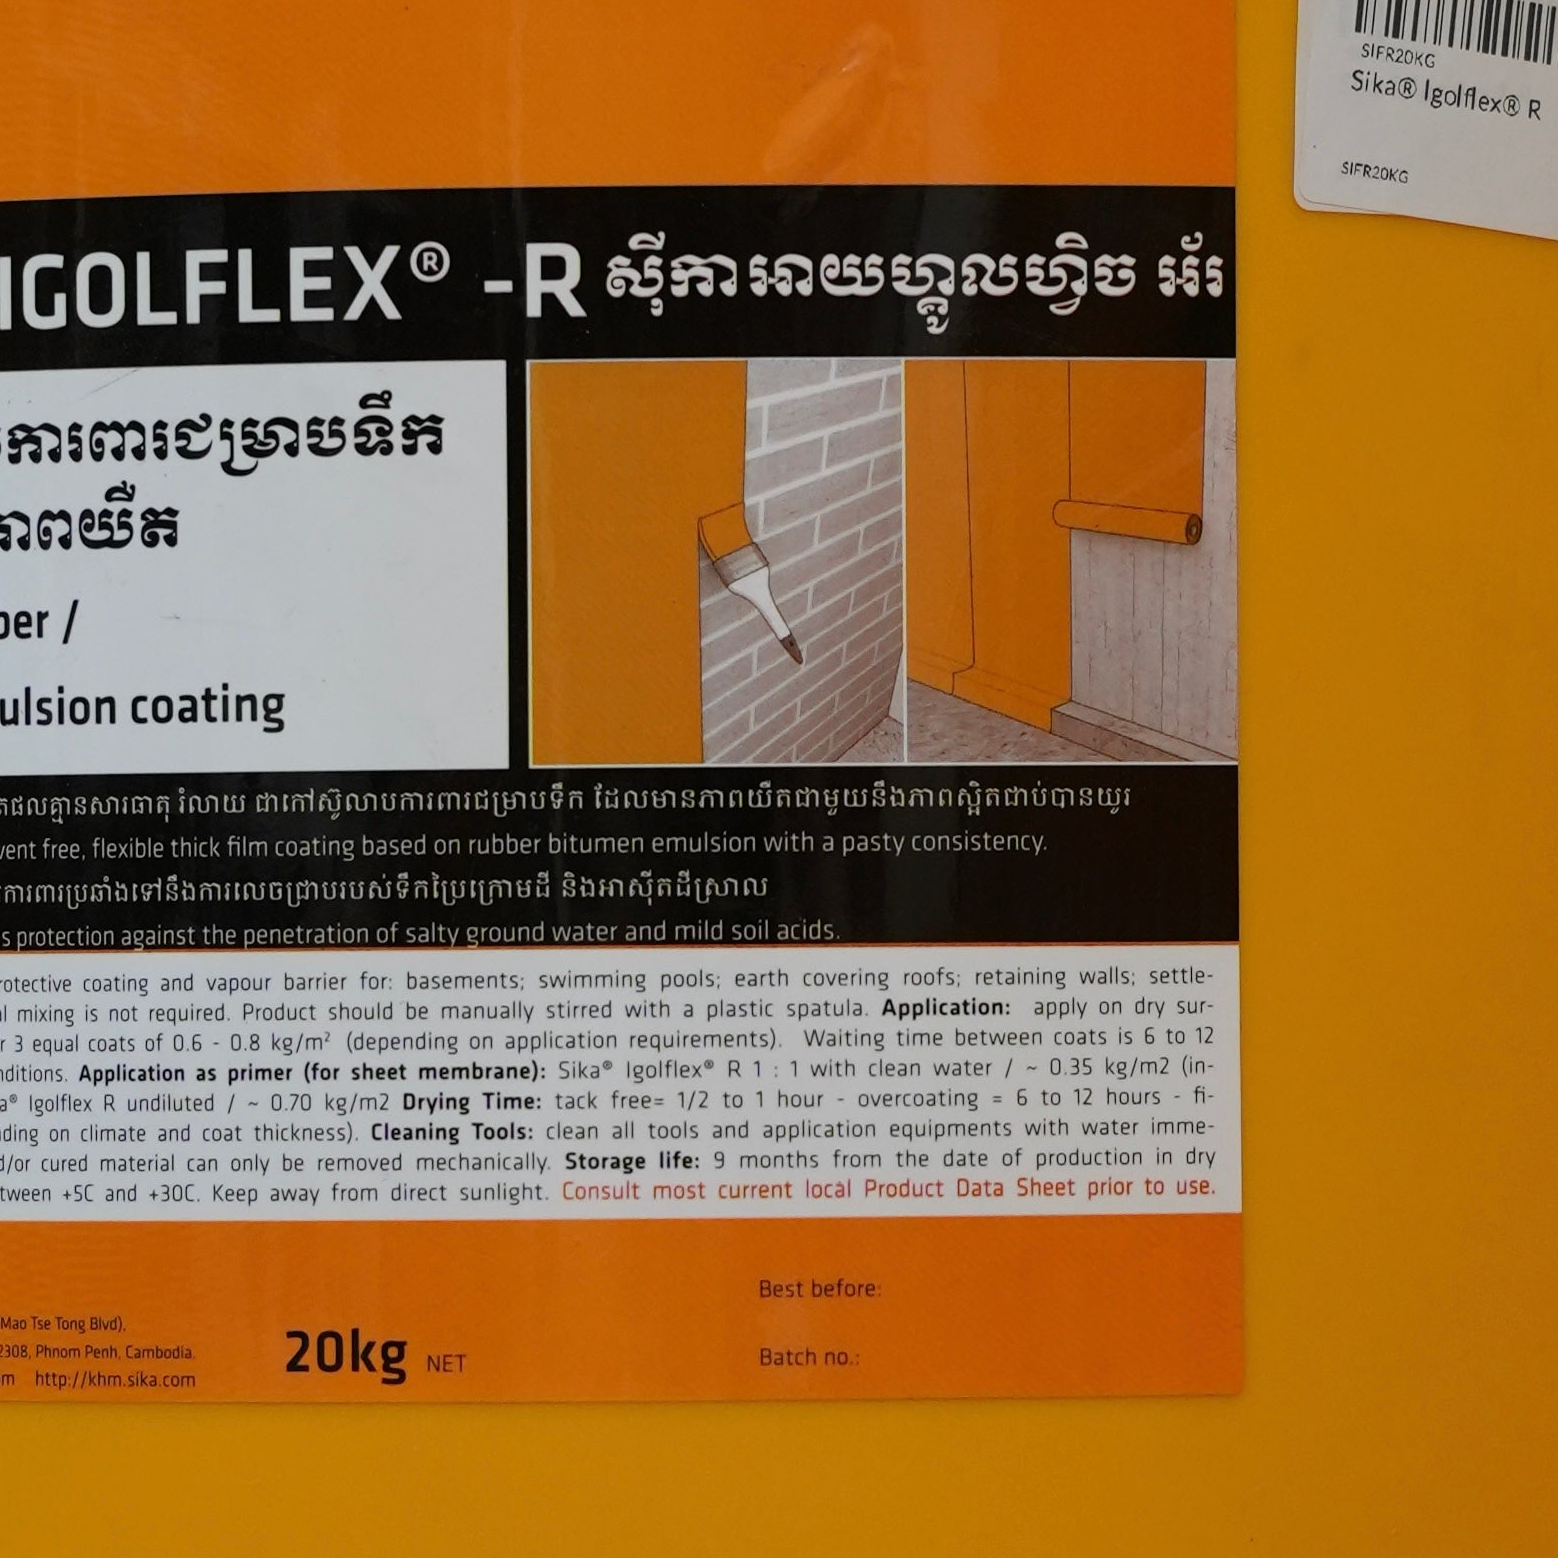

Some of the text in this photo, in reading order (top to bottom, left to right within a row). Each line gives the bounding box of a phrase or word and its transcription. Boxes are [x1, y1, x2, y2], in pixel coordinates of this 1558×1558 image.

[1360, 42, 1436, 70] SIFR20KG
[1350, 69, 1542, 121] Sika® Igolflex® R
[1340, 160, 1409, 185] SIFR20KG
[61, 598, 80, 645] /
[130, 682, 286, 734] coating
[42, 837, 86, 861] free,
[91, 836, 164, 859] flexible
[170, 835, 221, 858] thick
[226, 834, 268, 857] film
[274, 834, 355, 862] coating
[362, 833, 427, 857] based
[433, 838, 461, 856] on
[468, 832, 542, 855] rubber
[548, 832, 644, 855] bitumen
[651, 830, 756, 854] emulsion
[763, 830, 814, 853] with
[822, 835, 835, 852] a
[842, 832, 905, 857] pasty
[911, 829, 1047, 856] consistency.
[16, 924, 115, 951] protection
[121, 923, 196, 950] against
[201, 923, 237, 946] the
[243, 922, 369, 950] penetration
[376, 921, 399, 944] of
[405, 921, 460, 948] salty
[466, 920, 545, 948] ground
[551, 922, 619, 943] water
[625, 919, 666, 942] and
[674, 919, 723, 942] mild
[730, 918, 769, 941] soil
[776, 918, 840, 941] acids.
[82, 973, 149, 997] coating
[160, 972, 194, 992] and
[205, 976, 272, 996] vapour
[284, 971, 348, 992] barrier
[359, 970, 392, 991] for:
[406, 970, 524, 991] basements;
[538, 969, 647, 994] swimming
[660, 968, 721, 993] pools;
[734, 968, 789, 988] earth
[802, 967, 890, 992] covering
[903, 966, 961, 988] roofs;
[975, 966, 1067, 991] retaining
[1079, 965, 1135, 987] walls;
[1149, 965, 1214, 985] settle-
[62, 1183, 95, 1203] +5C
[104, 1183, 137, 1203] and
[148, 1183, 201, 1203] +30C.
[212, 1183, 258, 1208] Keep
[269, 1187, 321, 1207] away
[331, 1182, 378, 1202] from
[390, 1182, 448, 1202] direct
[459, 1182, 549, 1206] sunlight.
[562, 1180, 640, 1201] Consult
[653, 1182, 707, 1200] most
[718, 1181, 793, 1200] current
[805, 1178, 852, 1199] local
[864, 1178, 944, 1199] Product
[956, 1177, 1004, 1198] Data
[1017, 1176, 1076, 1197] Sheet
[1087, 1176, 1134, 1201] prior
[1144, 1177, 1165, 1196] to
[1176, 1179, 1216, 1195] use.
[759, 1277, 881, 1299] Best before:
[30, 1315, 52, 1331] Tse
[54, 1316, 87, 1335] Tong
[35, 1343, 81, 1359] Phnom
[285, 1327, 467, 1386] 20kg NET
[759, 1346, 817, 1367] Batch
[35, 1369, 196, 1391] http://khm.sika.com
